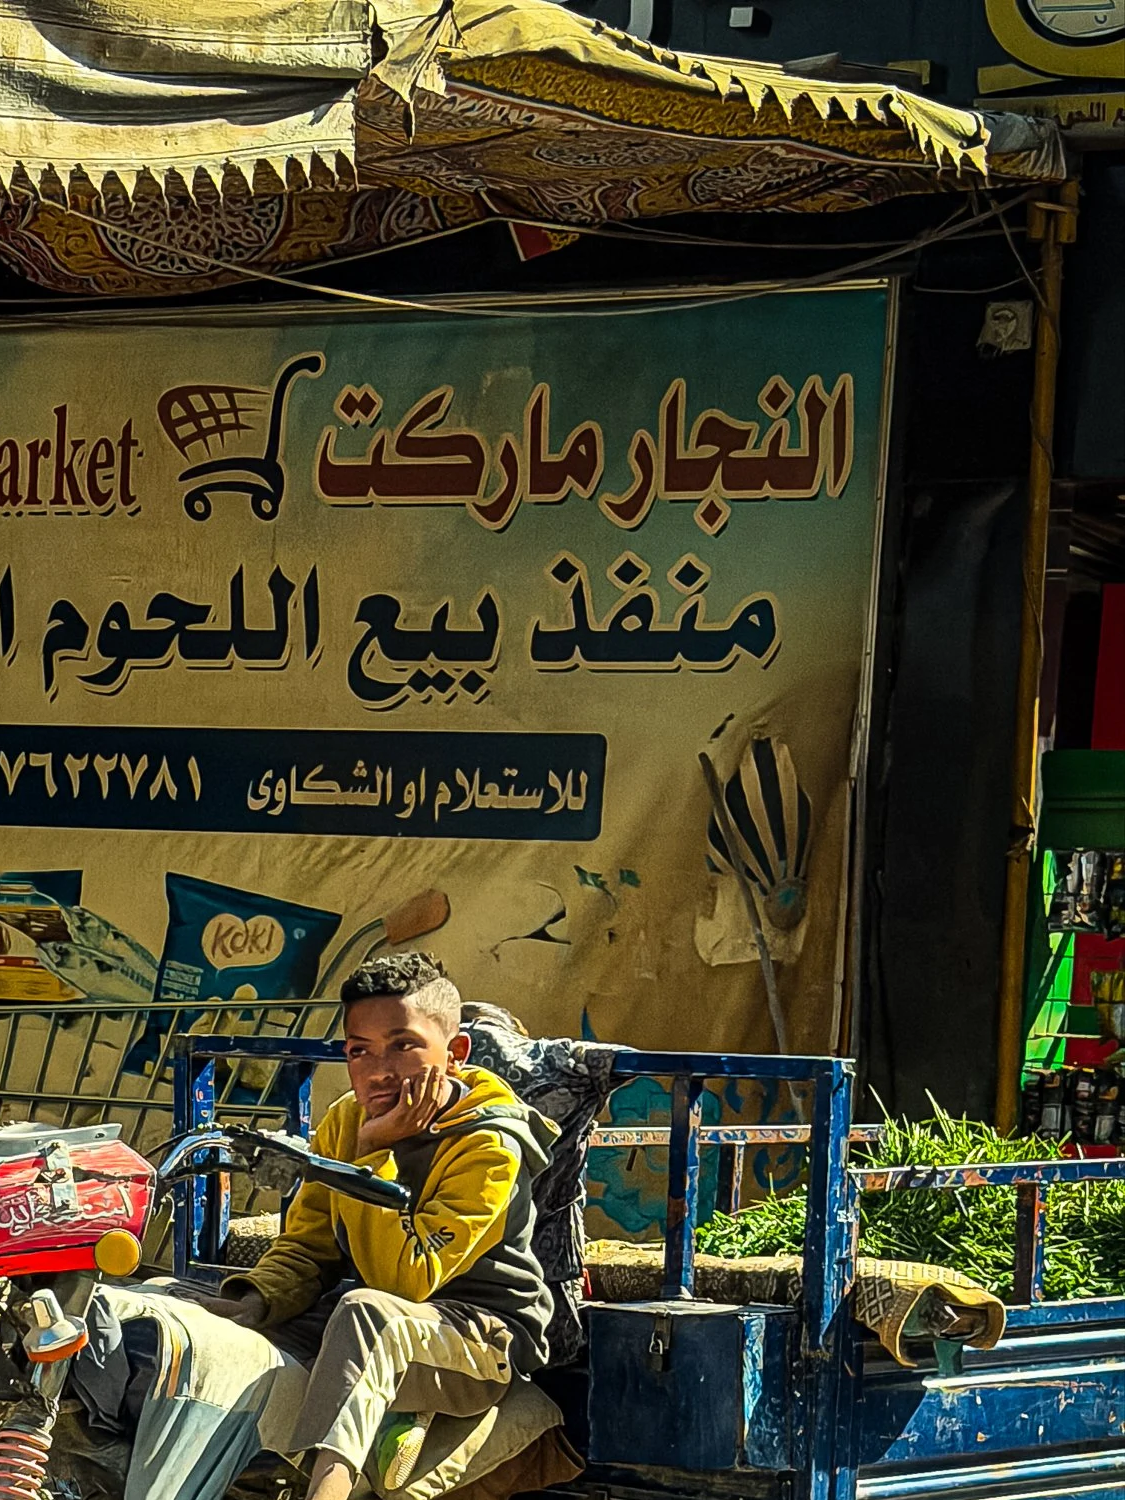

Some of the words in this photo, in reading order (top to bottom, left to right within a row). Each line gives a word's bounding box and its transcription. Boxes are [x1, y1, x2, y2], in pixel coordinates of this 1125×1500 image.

[318, 383, 602, 529] ماركت
[602, 376, 852, 533] النجار
[43, 563, 320, 697] اللحوم
[348, 587, 500, 707] بيع
[531, 554, 778, 671] منفذ
[246, 759, 393, 816] الشكاوى
[394, 766, 426, 819] او
[434, 766, 588, 823] للاستعلام
[211, 921, 275, 959] KOKI
